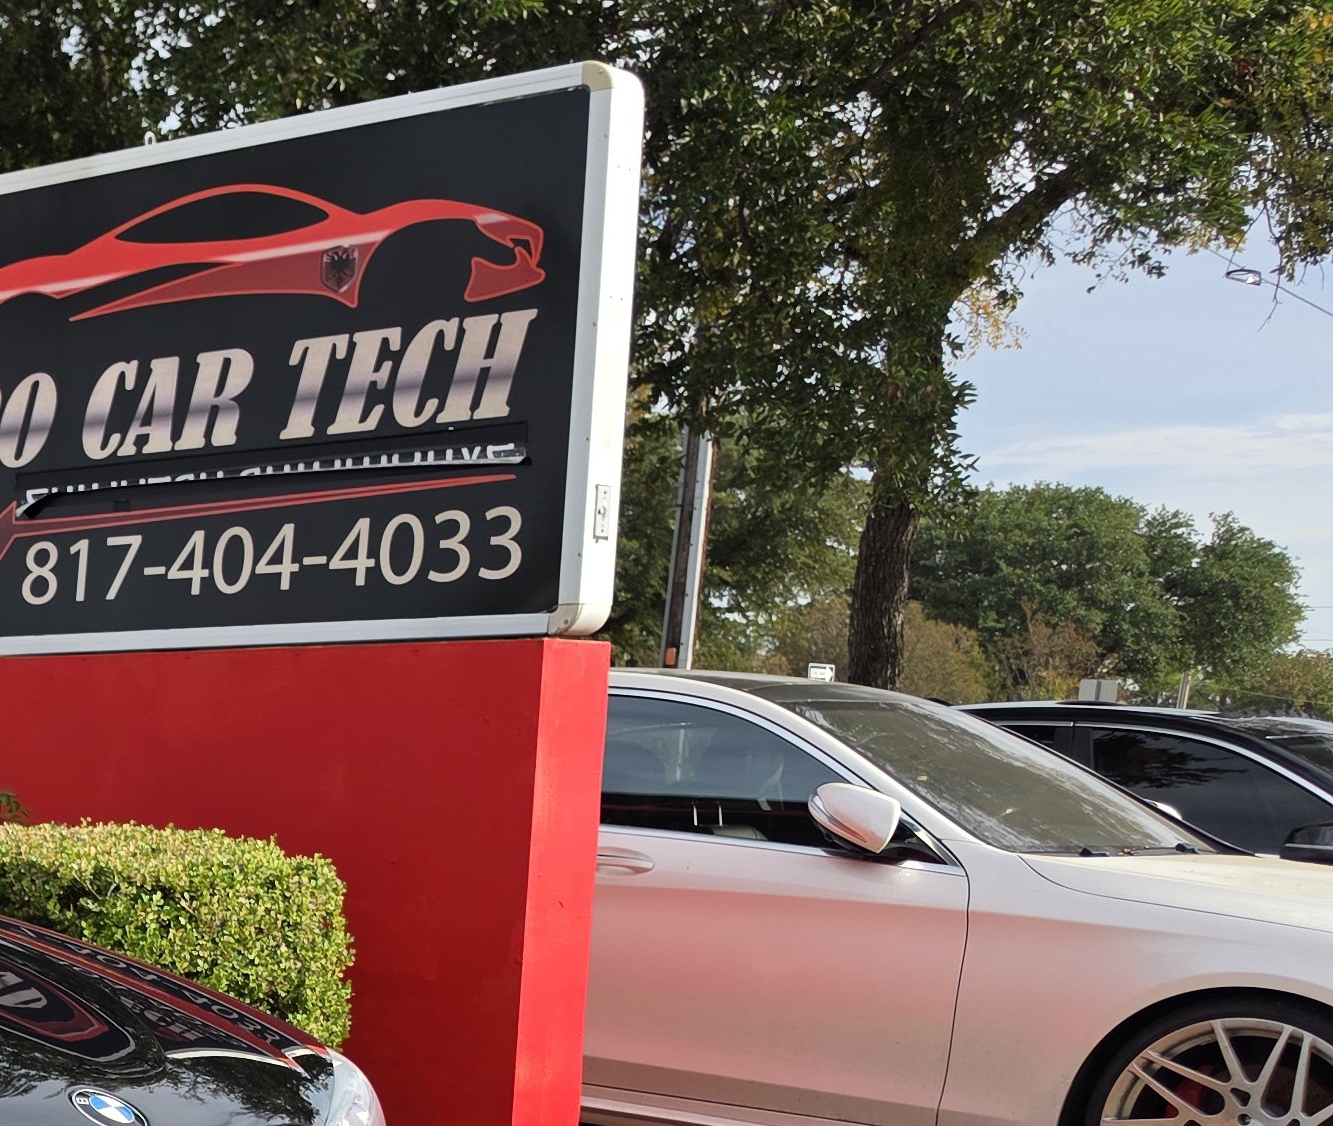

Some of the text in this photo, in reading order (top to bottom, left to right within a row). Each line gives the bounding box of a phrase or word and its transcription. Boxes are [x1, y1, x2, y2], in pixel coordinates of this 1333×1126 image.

[83, 347, 256, 459] CAR
[278, 308, 538, 440] TECH
[22, 505, 524, 606] 817-404-4033
